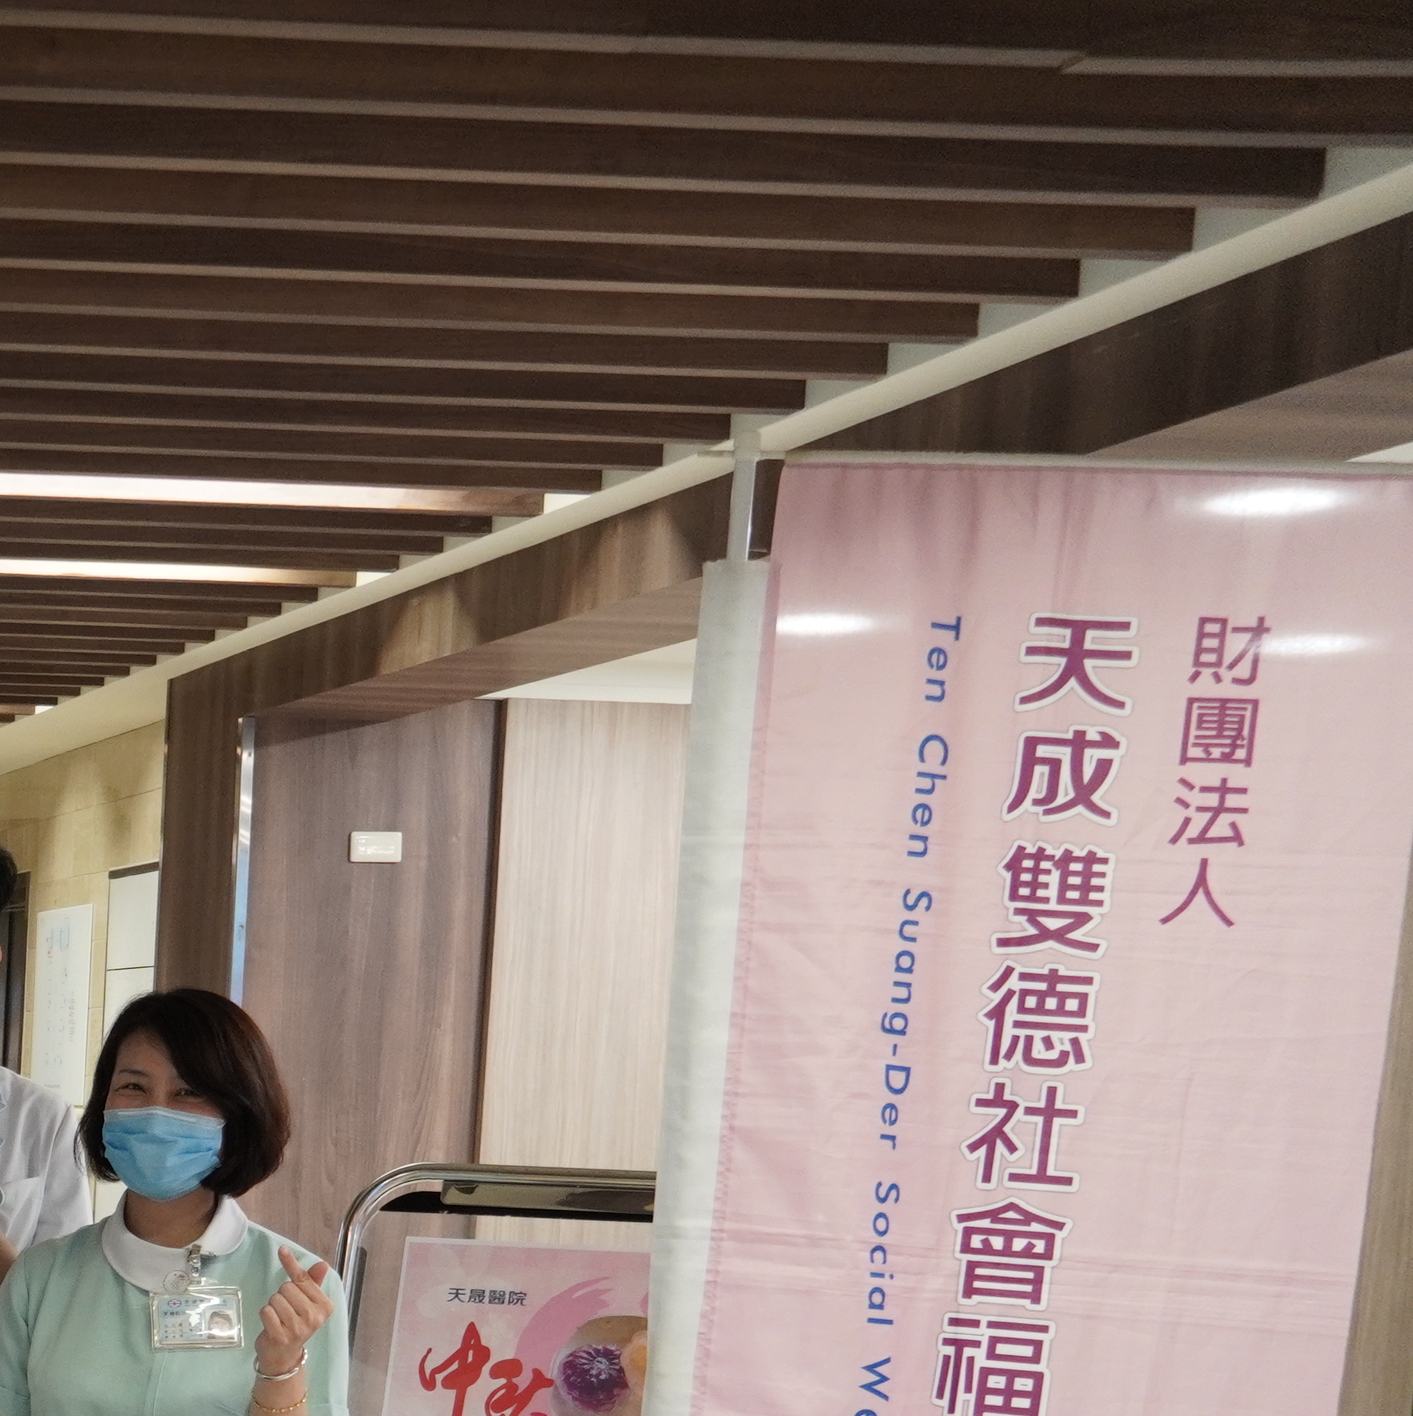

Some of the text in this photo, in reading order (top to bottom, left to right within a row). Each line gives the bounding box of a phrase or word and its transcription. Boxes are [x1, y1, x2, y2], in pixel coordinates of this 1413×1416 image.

[924, 615, 962, 703] Ten
[906, 734, 949, 859] Chen
[1159, 615, 1271, 928] 財團法人
[878, 888, 933, 1150] Suang-Der
[447, 1288, 527, 1307] 天晟醫院
[866, 1180, 902, 1326] Social
